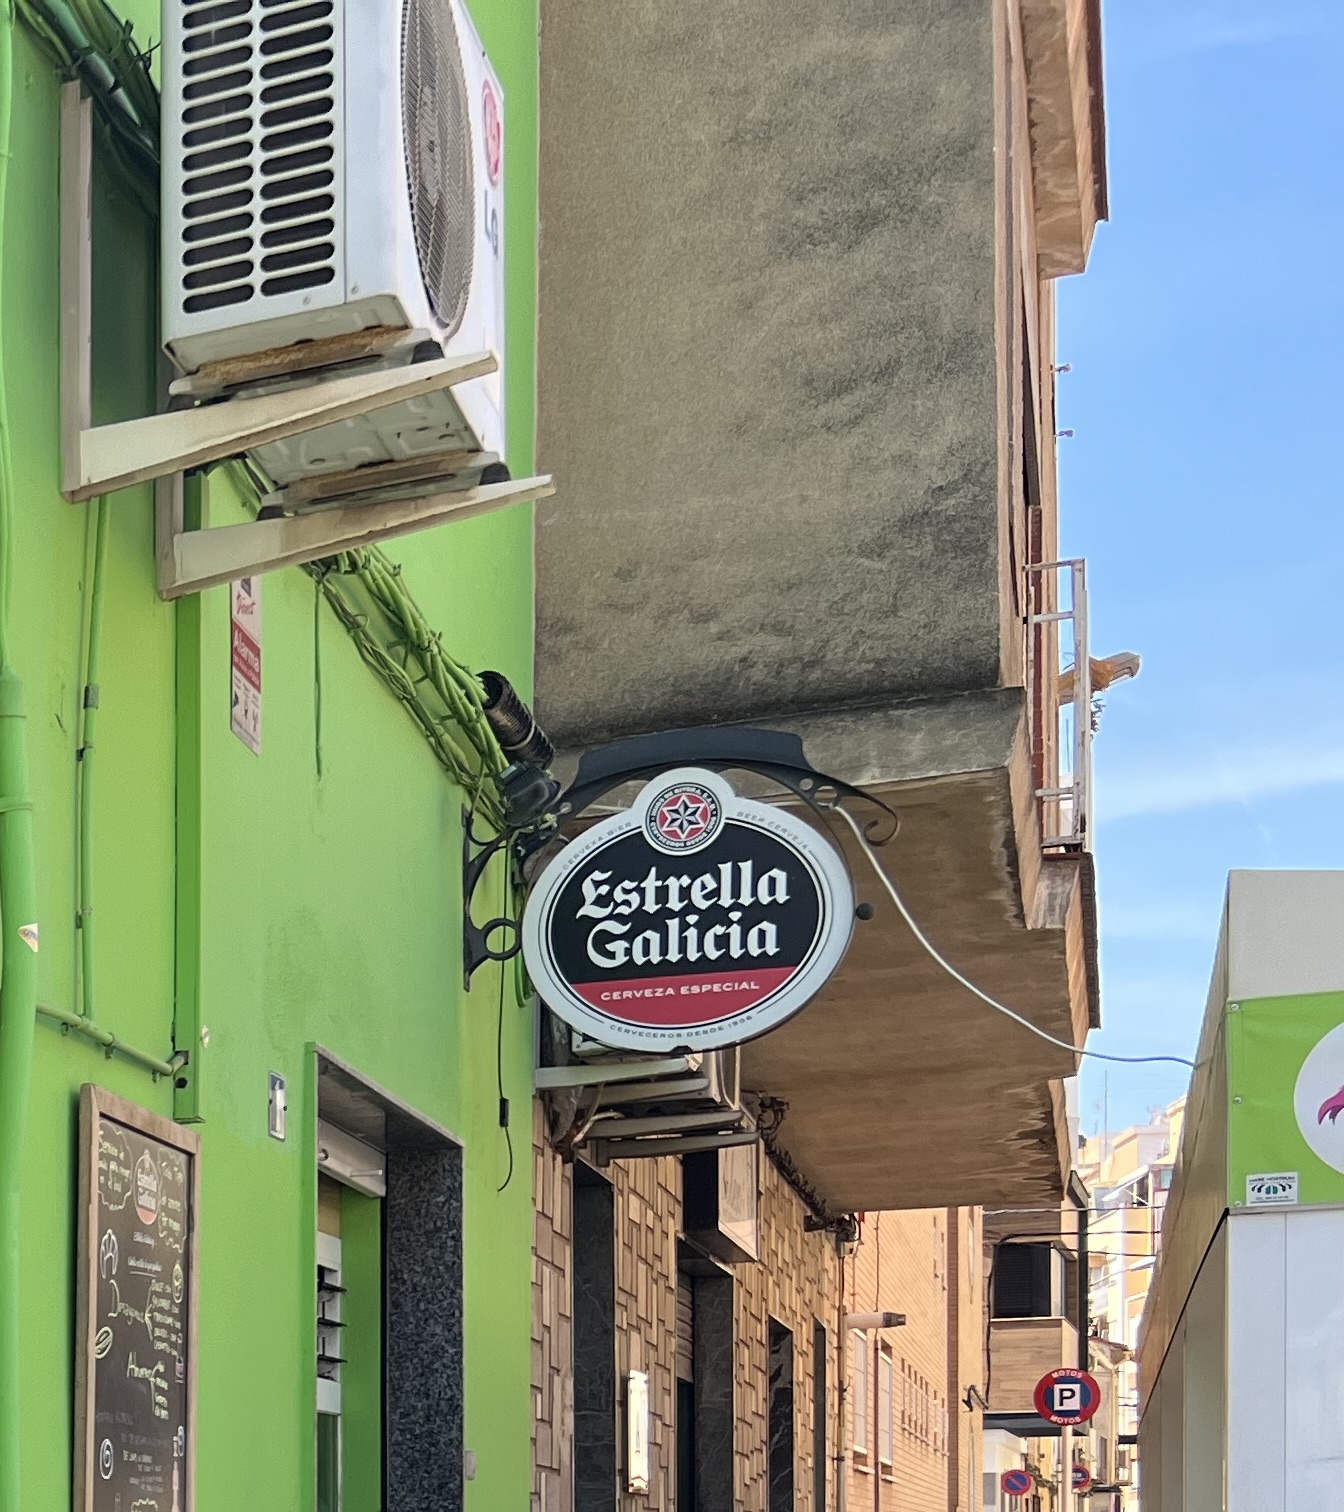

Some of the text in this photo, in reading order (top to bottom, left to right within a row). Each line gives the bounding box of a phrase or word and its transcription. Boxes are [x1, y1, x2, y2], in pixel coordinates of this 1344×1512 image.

[576, 859, 791, 920] Estrella
[586, 911, 781, 969] Galicia
[600, 981, 761, 1001] CERVEZA ESPECIAL
[609, 1024, 683, 1039] CERVECEROS
[686, 1025, 725, 1038] DESDE
[1052, 1369, 1083, 1379] MOTOS
[1058, 1388, 1076, 1407] P
[1050, 1415, 1081, 1424] MOTOS
